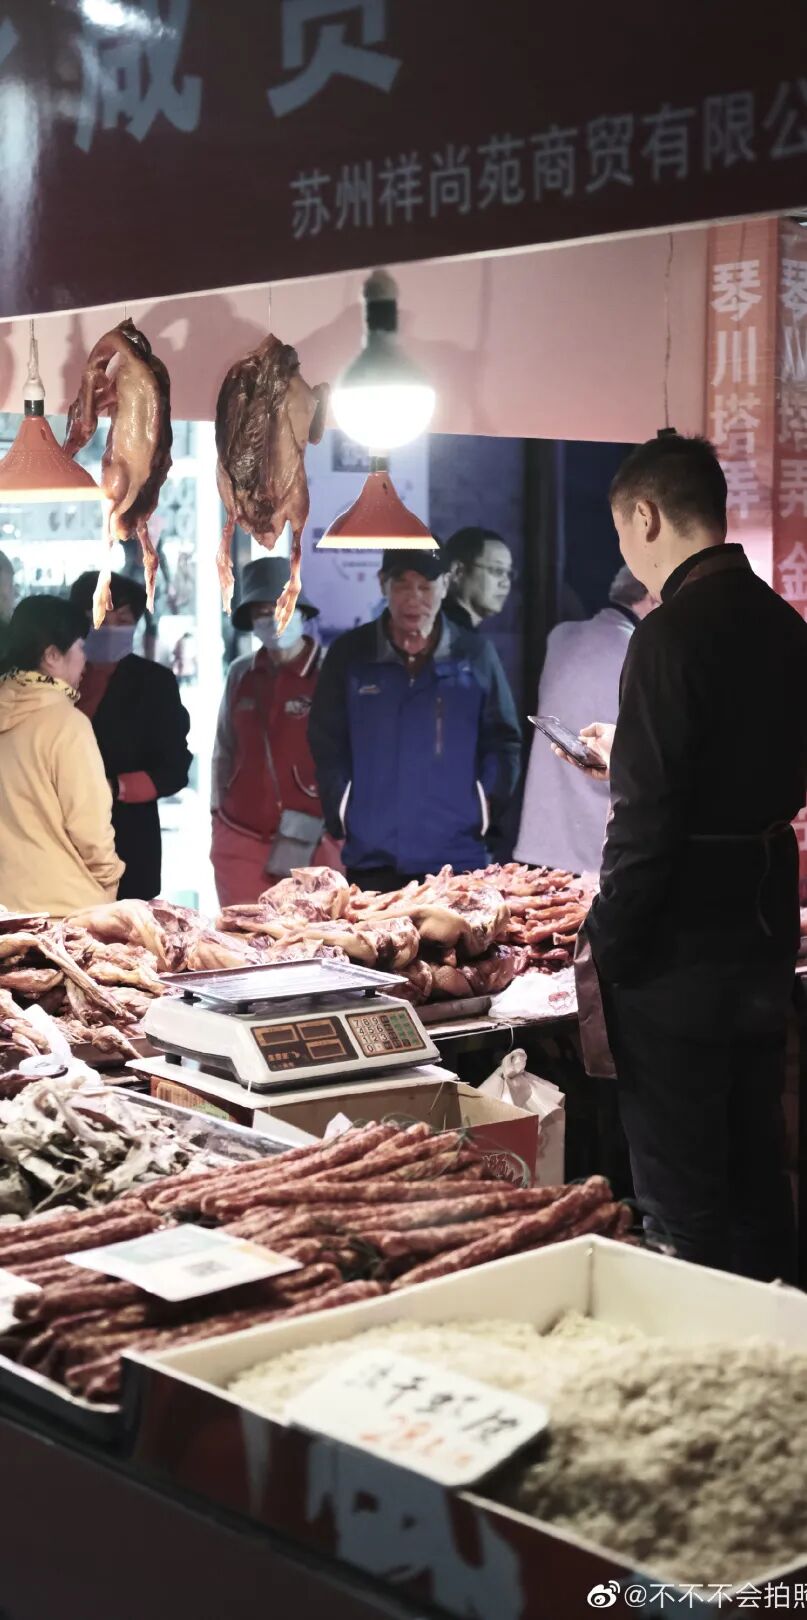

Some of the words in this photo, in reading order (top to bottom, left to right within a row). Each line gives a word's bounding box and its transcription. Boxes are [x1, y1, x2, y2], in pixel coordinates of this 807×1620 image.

[289, 77, 807, 240] 苏州祥尚苑商贸有限公
